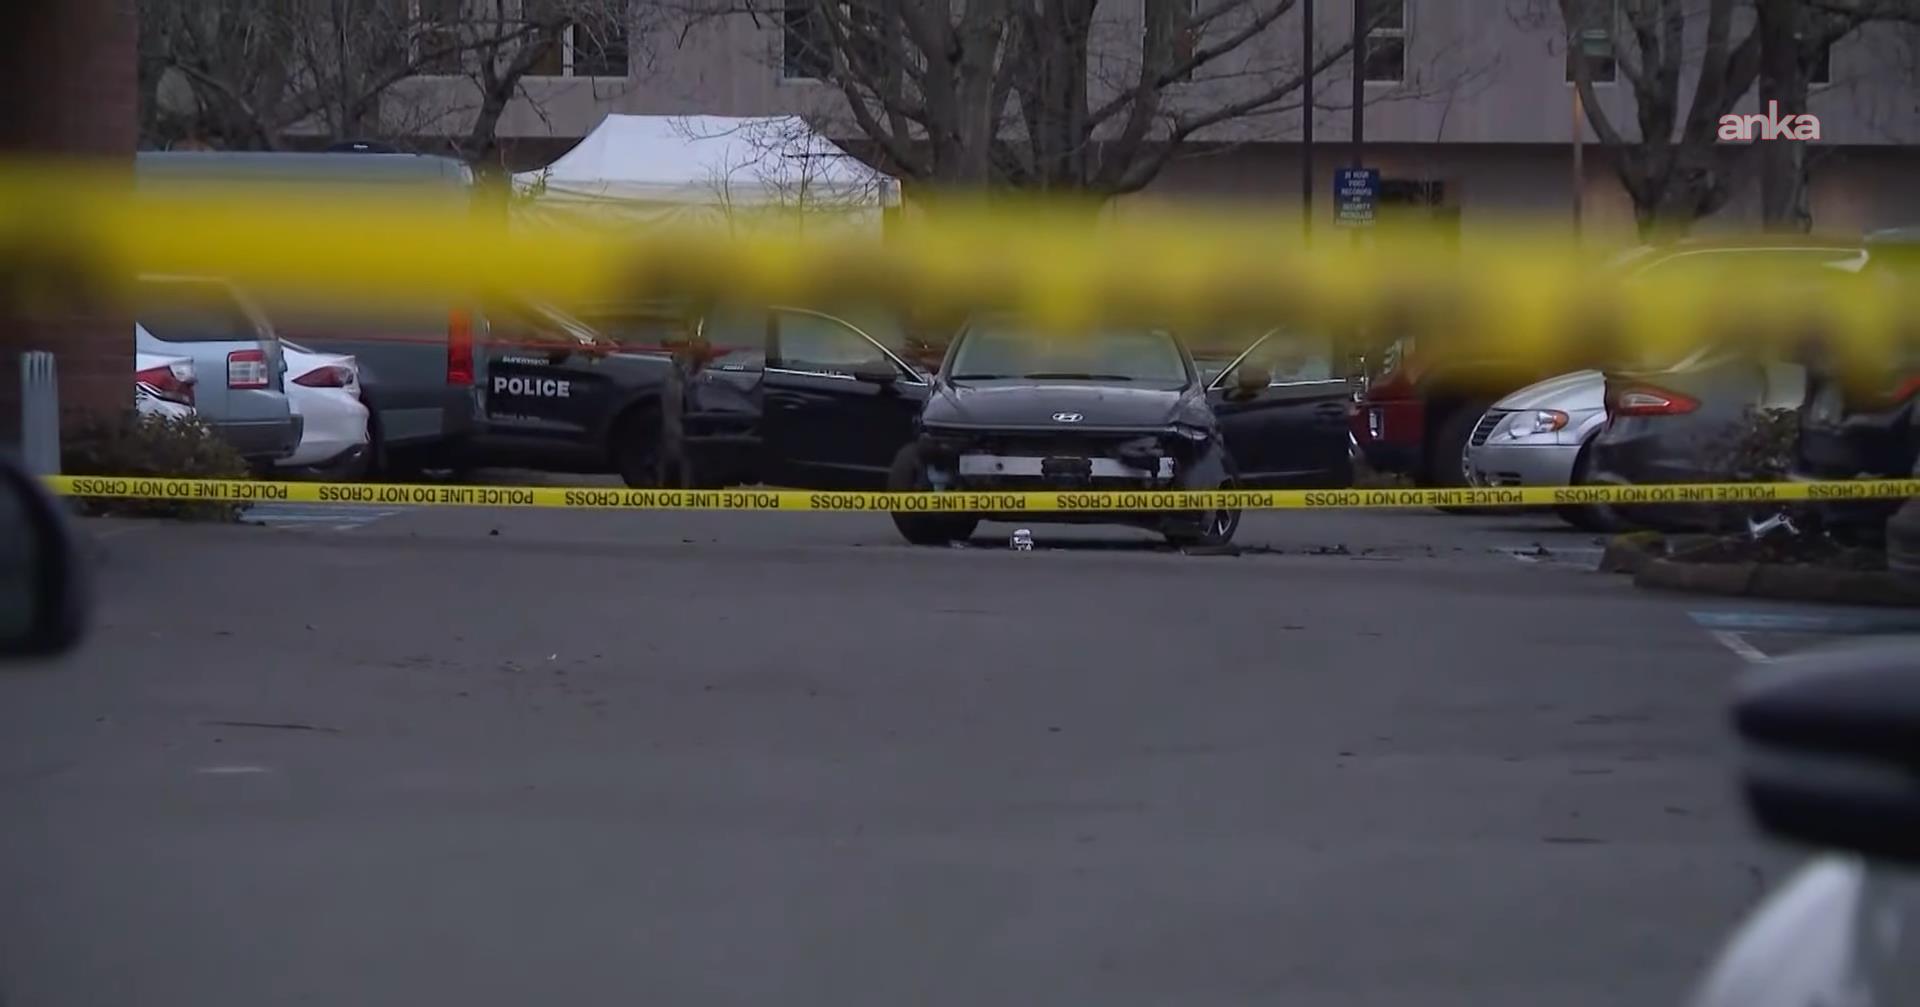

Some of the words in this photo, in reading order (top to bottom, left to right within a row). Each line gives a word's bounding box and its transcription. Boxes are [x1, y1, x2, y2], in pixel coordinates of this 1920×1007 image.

[494, 376, 570, 397] POLICE
[72, 480, 127, 495] CROSS
[131, 482, 163, 496] NOT
[166, 483, 189, 496] DO
[194, 483, 227, 497] LINE
[232, 484, 287, 499] POLICE
[319, 486, 373, 501] CROSS
[1614, 488, 1647, 501] NOT
[1651, 487, 1674, 500] DO
[1679, 486, 1713, 500] LINE
[1718, 485, 1775, 499] POLICE
[1808, 483, 1865, 497] CROSS
[1869, 483, 1901, 496] NOT
[378, 488, 409, 502] NOT
[413, 489, 435, 502] DO
[440, 489, 473, 503] LINE
[478, 490, 533, 504] POLICE
[565, 491, 619, 505] CROSS
[623, 492, 655, 506] NOT
[658, 493, 681, 506] DO
[686, 493, 719, 507] LINE
[723, 494, 779, 507] POLICE
[811, 494, 865, 508] CROSS
[869, 495, 901, 508] NOT
[905, 495, 928, 508] DO
[932, 495, 965, 508] LINE
[970, 495, 1025, 508] POLICE
[1057, 495, 1112, 508] CROSS
[1114, 495, 1147, 508] NOT
[1152, 495, 1175, 508] DO
[1179, 494, 1213, 508] LINE
[1217, 494, 1273, 507] POLICE
[1305, 493, 1360, 506] CROSS
[1363, 492, 1396, 505] NOT
[1400, 492, 1423, 505] DO
[1427, 491, 1461, 505] LINE
[1466, 490, 1523, 504] POLICE
[1554, 488, 1611, 502] CROSS
